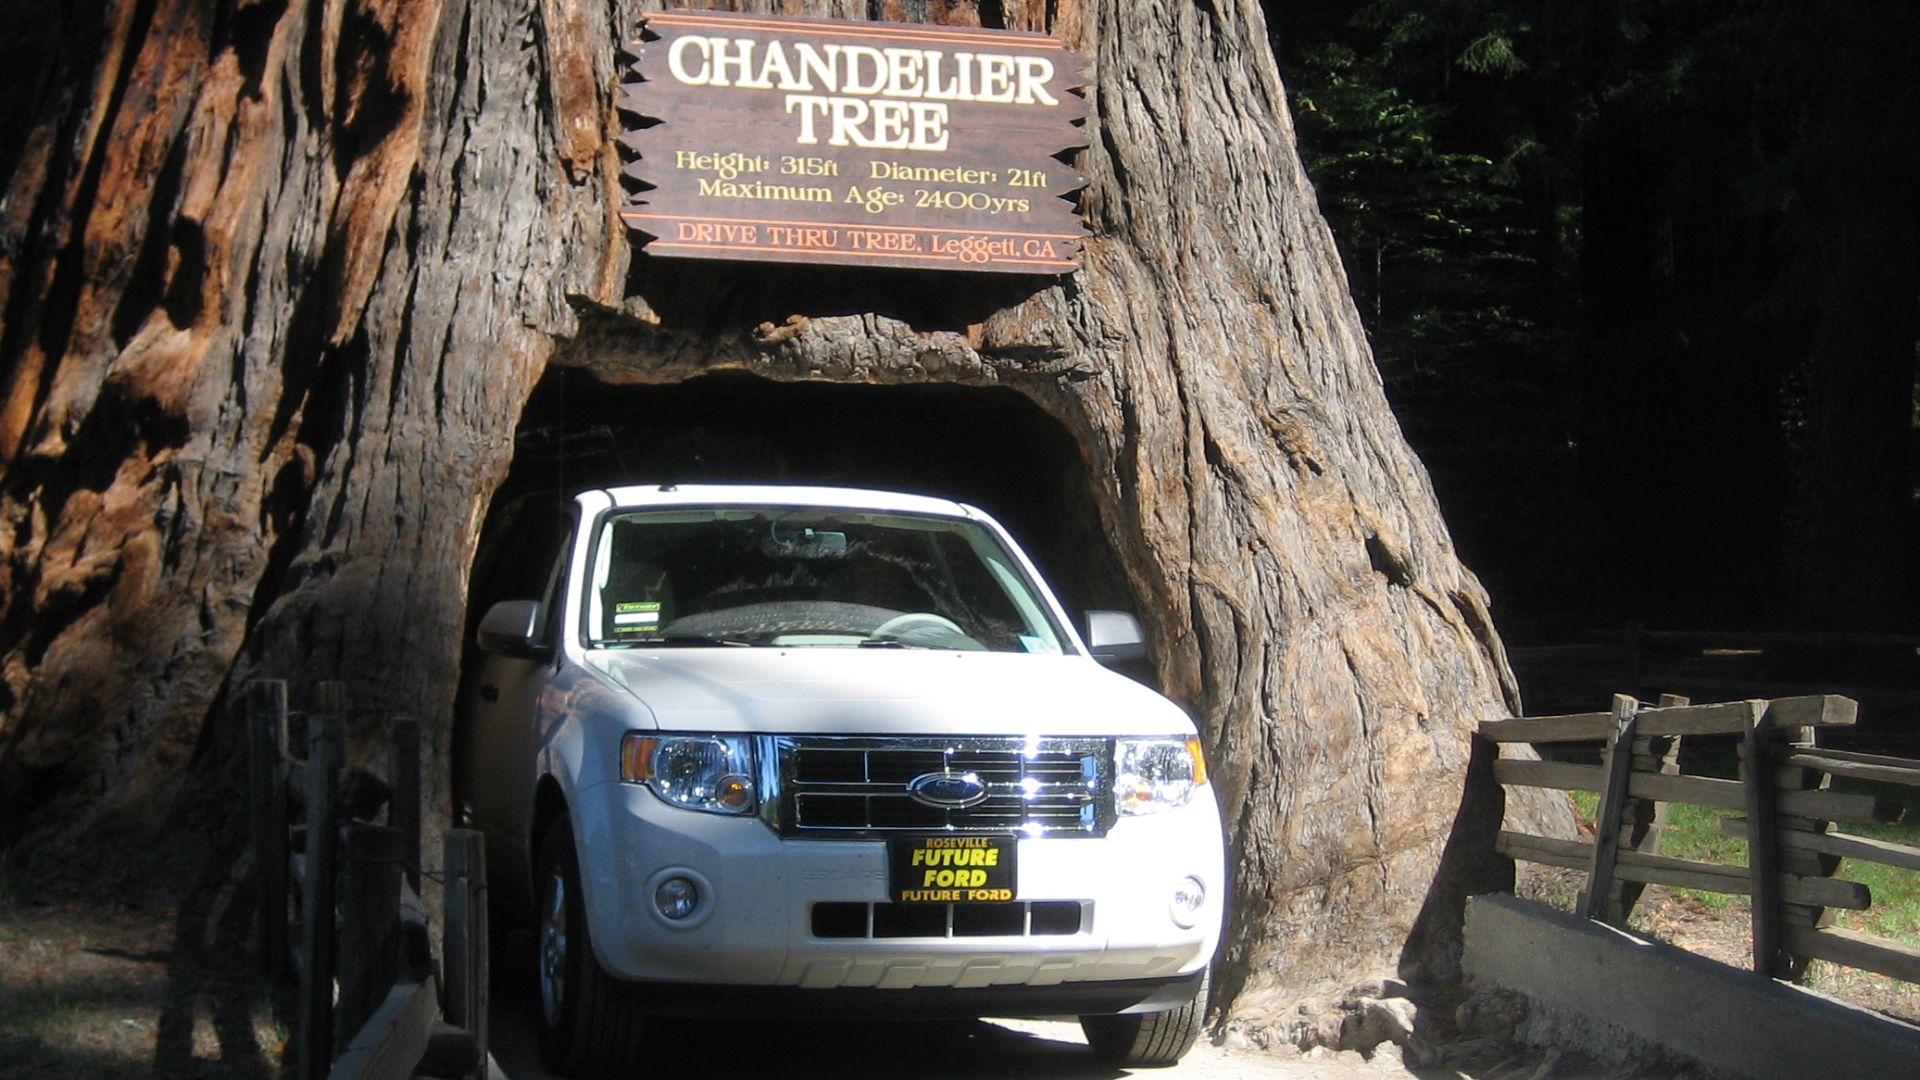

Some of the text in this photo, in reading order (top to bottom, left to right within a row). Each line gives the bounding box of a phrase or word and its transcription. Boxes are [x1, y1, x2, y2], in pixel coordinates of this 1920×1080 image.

[668, 35, 1060, 106] CHANDELIER
[785, 94, 950, 152] TREE
[675, 150, 1048, 188] Height: 315ft Diameter: 21ft
[698, 178, 1031, 214] Maximum Age: 2400yrs
[678, 222, 757, 244] DRIVE
[766, 226, 838, 248] THRU
[1023, 239, 1058, 258] CA
[911, 848, 999, 867] FUTURE
[926, 838, 988, 848] ROSEVILLE
[902, 889, 1013, 901] FUTURE FORD
[923, 869, 988, 888] FORD
